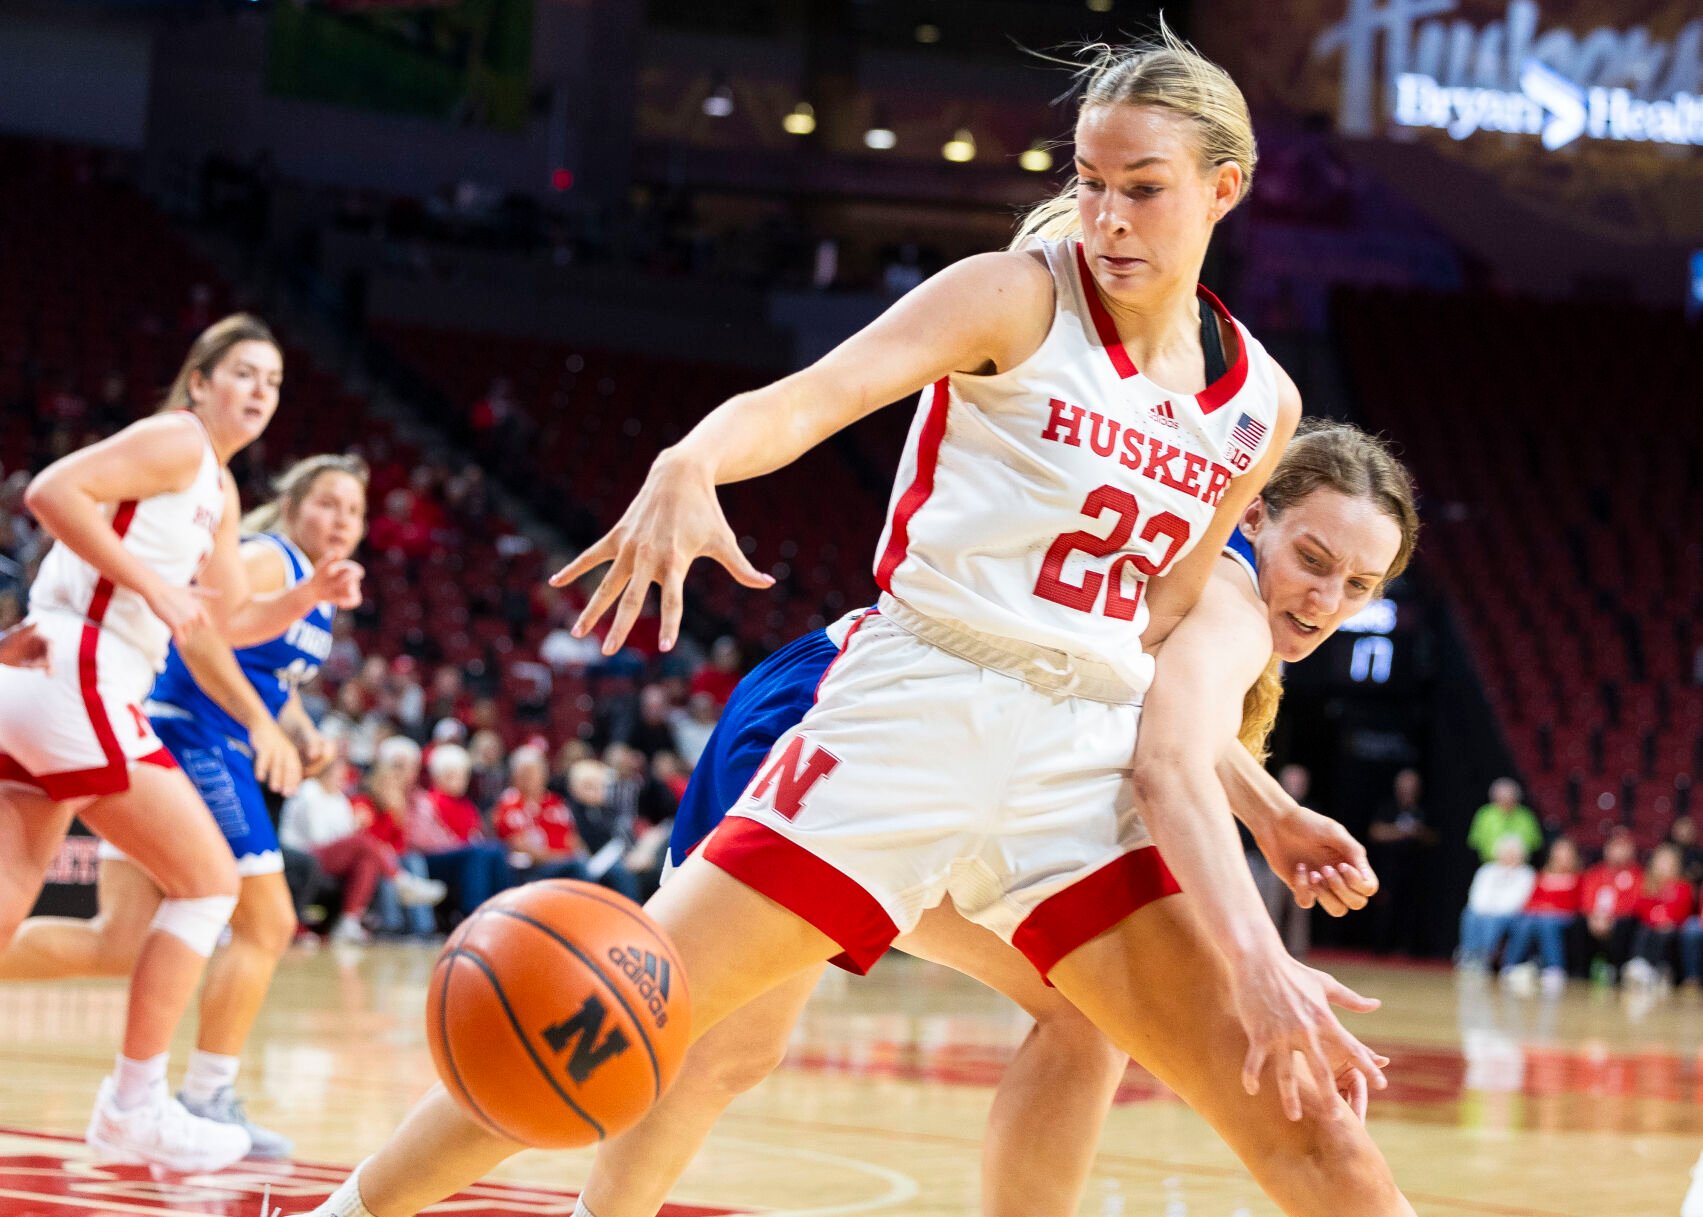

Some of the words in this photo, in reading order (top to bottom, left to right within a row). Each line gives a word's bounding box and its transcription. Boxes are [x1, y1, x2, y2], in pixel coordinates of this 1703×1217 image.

[1397, 72, 1544, 141] Bryan
[1033, 484, 1190, 622] 22
[750, 732, 843, 824] N
[608, 946, 668, 1029] adidas
[542, 994, 632, 1085] N
